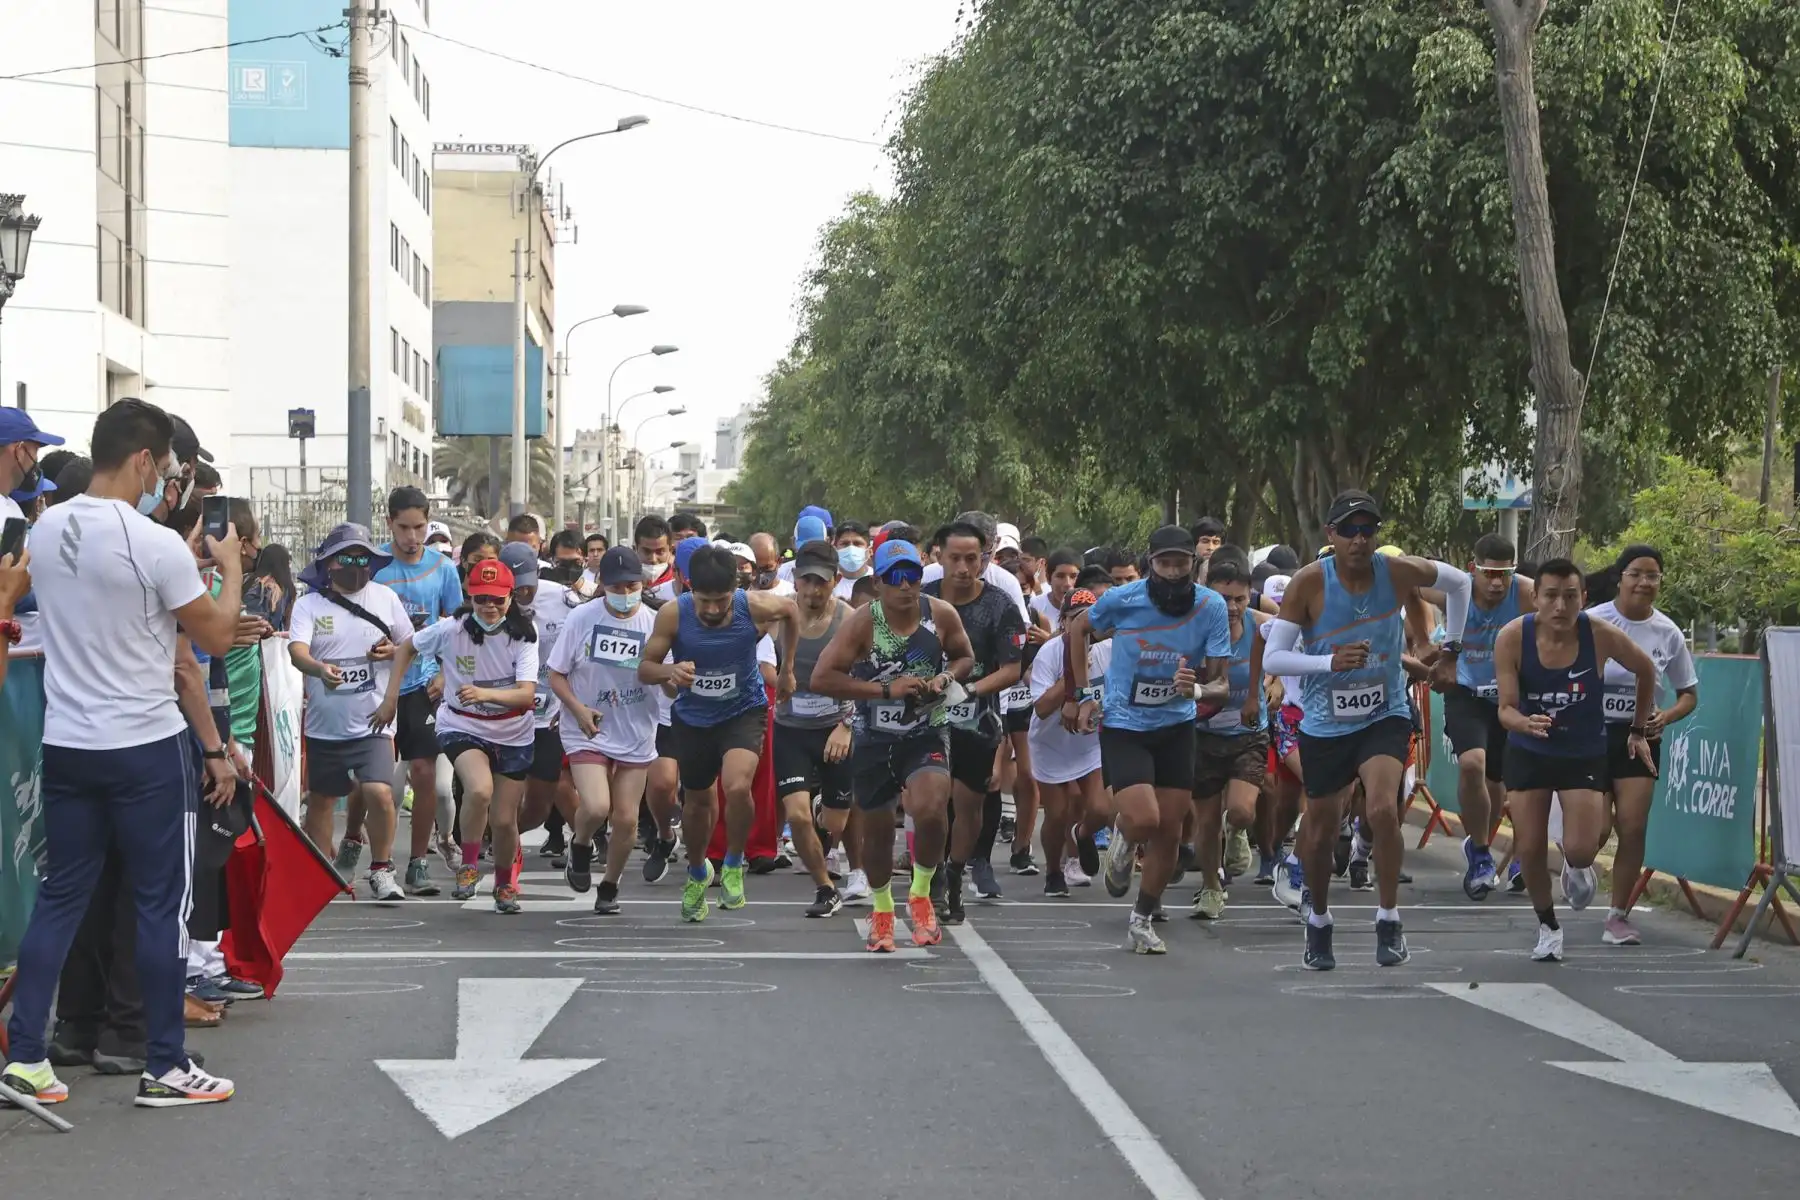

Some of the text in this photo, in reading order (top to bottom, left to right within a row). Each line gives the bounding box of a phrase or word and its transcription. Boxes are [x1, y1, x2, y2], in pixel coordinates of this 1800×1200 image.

[599, 639, 637, 656] 6174
[695, 678, 731, 690] 4292
[1007, 689, 1032, 702] 925
[1335, 690, 1381, 710] 3402
[1691, 780, 1738, 819] CORRE
